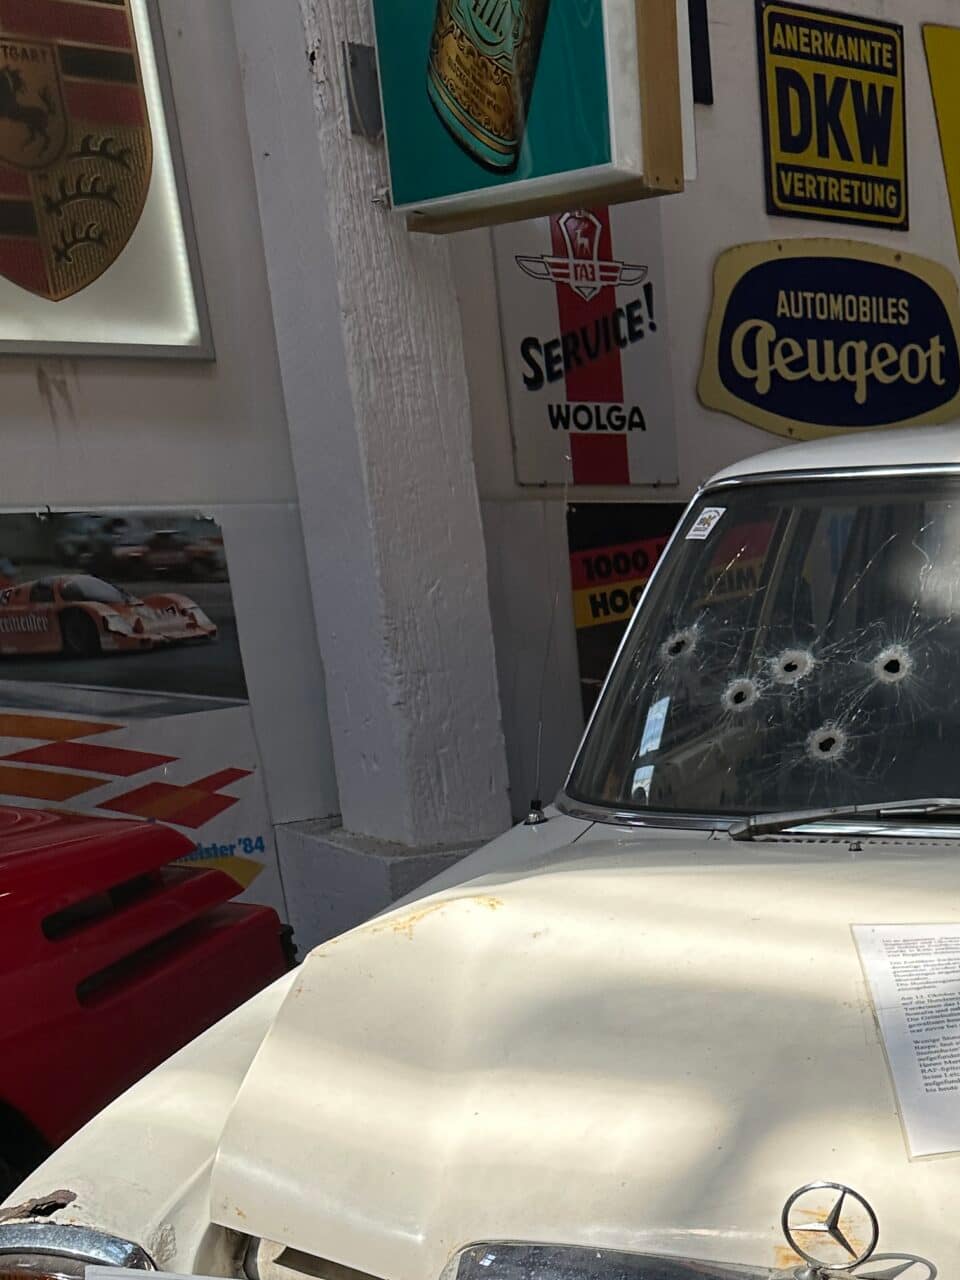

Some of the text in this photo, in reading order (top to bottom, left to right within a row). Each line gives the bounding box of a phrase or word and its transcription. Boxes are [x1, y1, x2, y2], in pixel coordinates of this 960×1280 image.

[772, 22, 894, 68] ANERKANNTE
[776, 67, 894, 168] DKW
[779, 170, 898, 210] VERTRETUNG
[776, 290, 910, 326] AUTOMOBILES
[520, 281, 657, 392] SERVICE!
[731, 318, 946, 405] Peugeot
[548, 404, 647, 432] WOLGA
[583, 549, 650, 582] 1000
